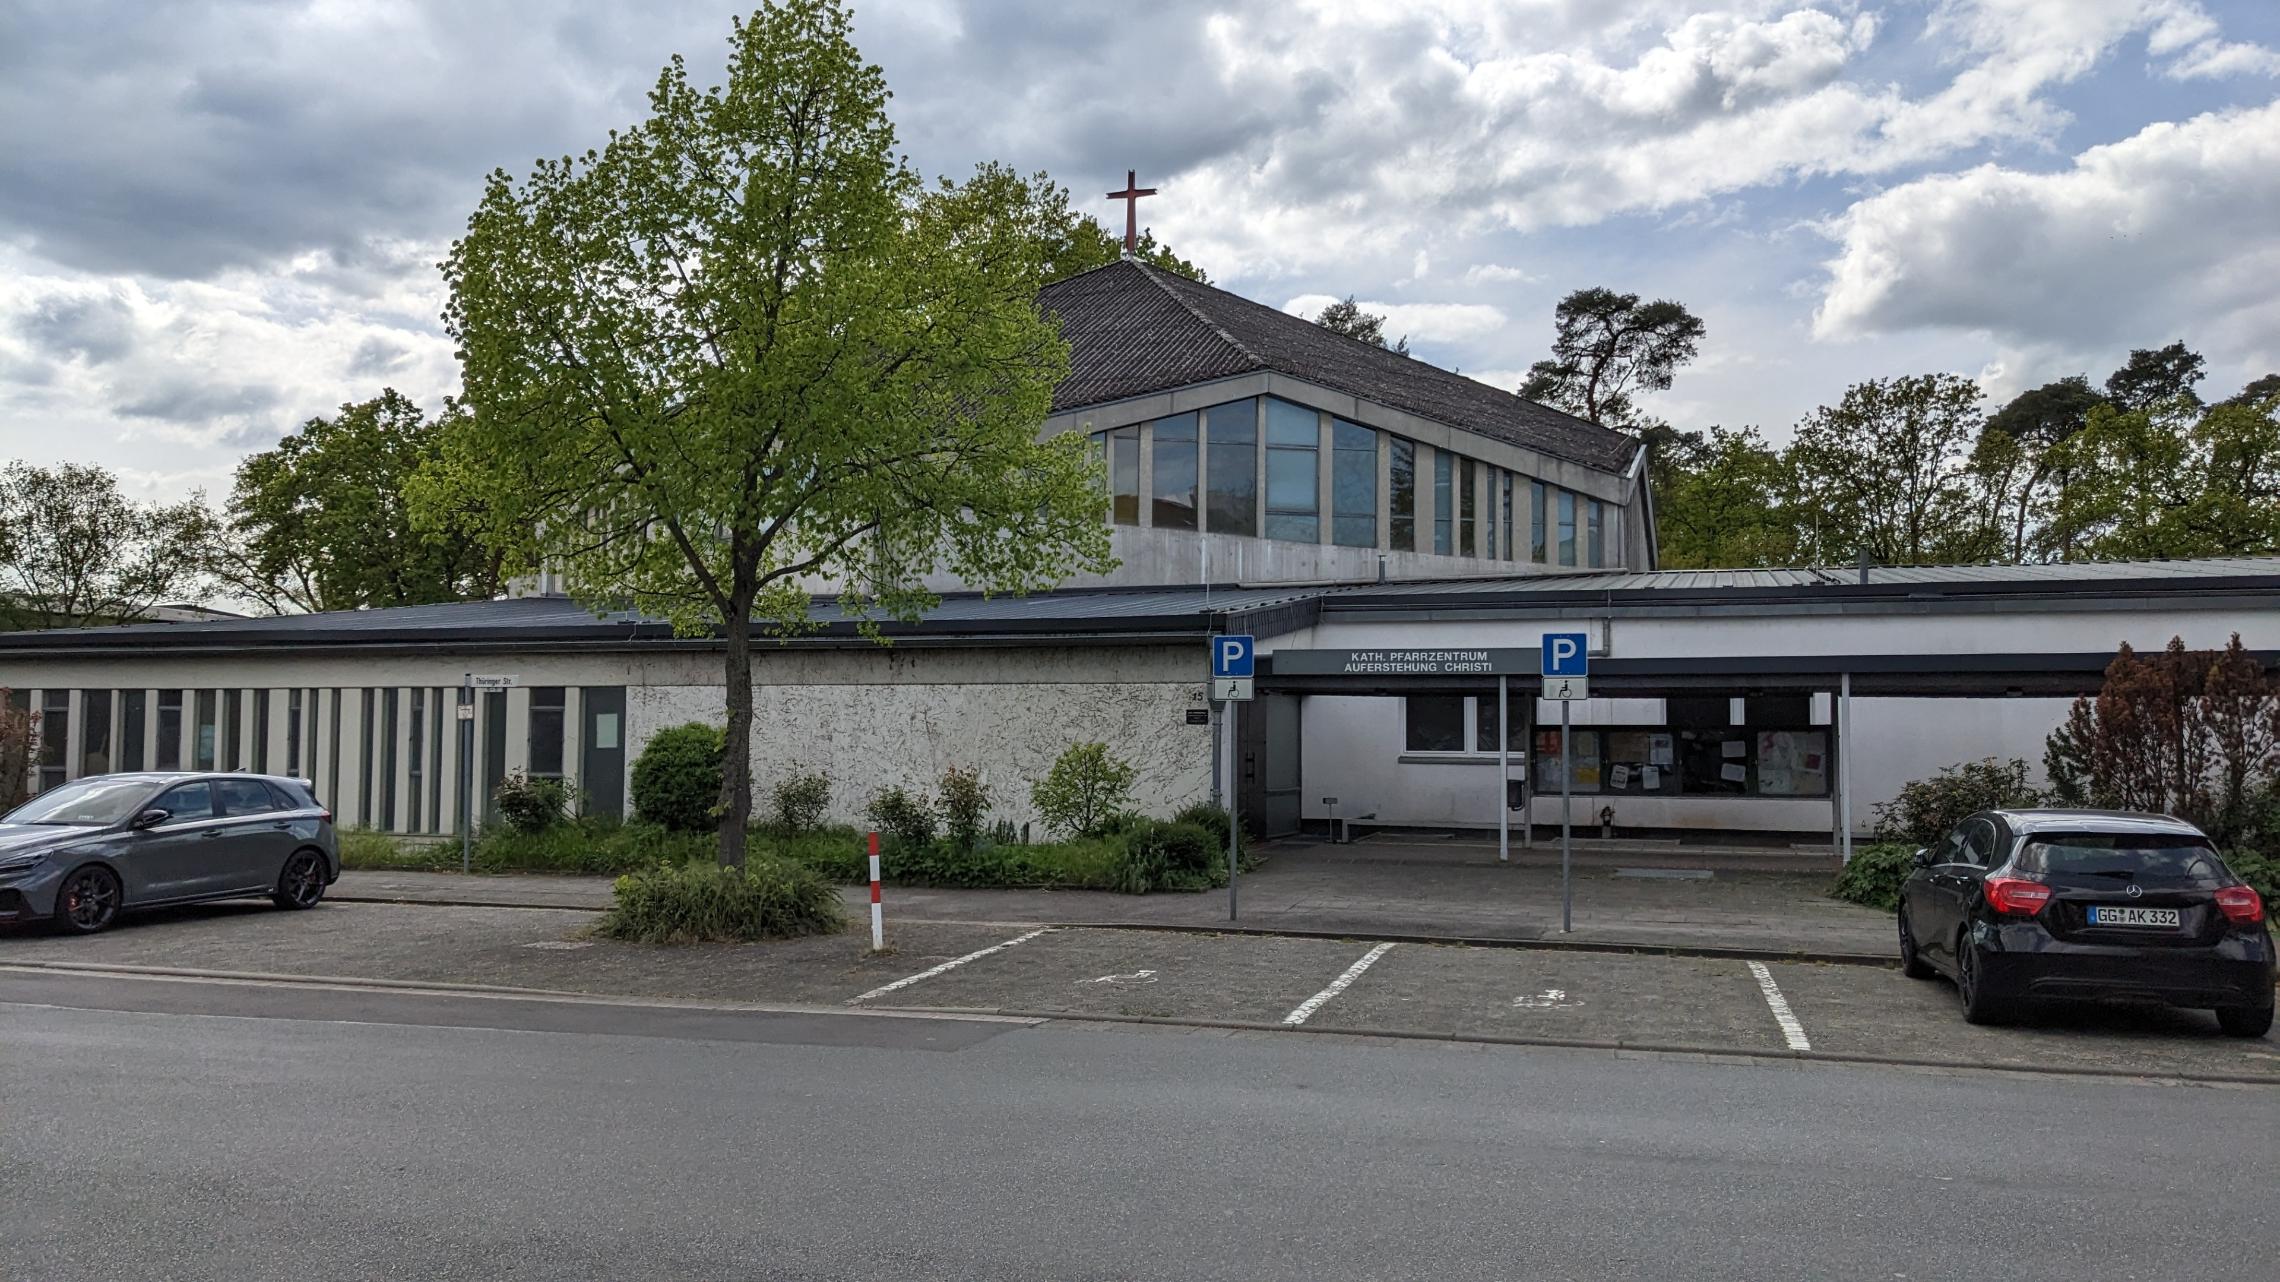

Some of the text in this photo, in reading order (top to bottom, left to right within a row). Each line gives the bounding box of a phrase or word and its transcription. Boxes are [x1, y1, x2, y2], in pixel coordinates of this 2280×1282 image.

[1223, 641, 1244, 672] P
[1351, 652, 1487, 662] KATH. PFARRZENTRUM
[1552, 638, 1577, 671] P
[1344, 663, 1492, 672] AUFERSTEHUNG CHRISTI
[503, 677, 512, 685] Str.
[1192, 692, 1204, 701] 15
[2098, 909, 2177, 925] GG AK 332
